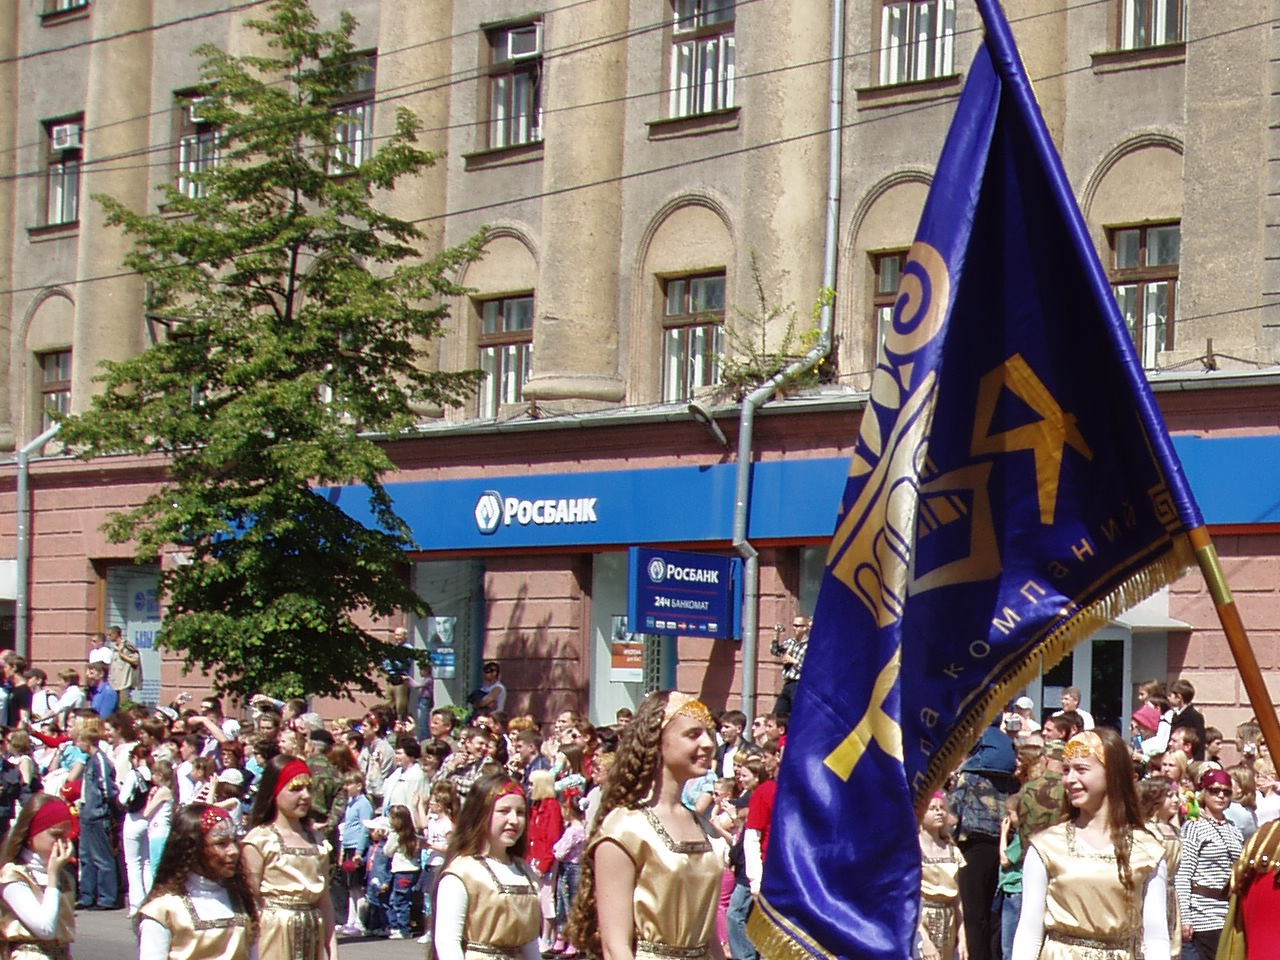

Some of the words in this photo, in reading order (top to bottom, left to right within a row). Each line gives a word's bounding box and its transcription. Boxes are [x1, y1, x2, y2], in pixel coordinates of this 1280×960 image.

[504, 497, 598, 525] РОСБАНК
[666, 564, 719, 584] РОСБАНК
[671, 599, 710, 611] БАНКОМАТ
